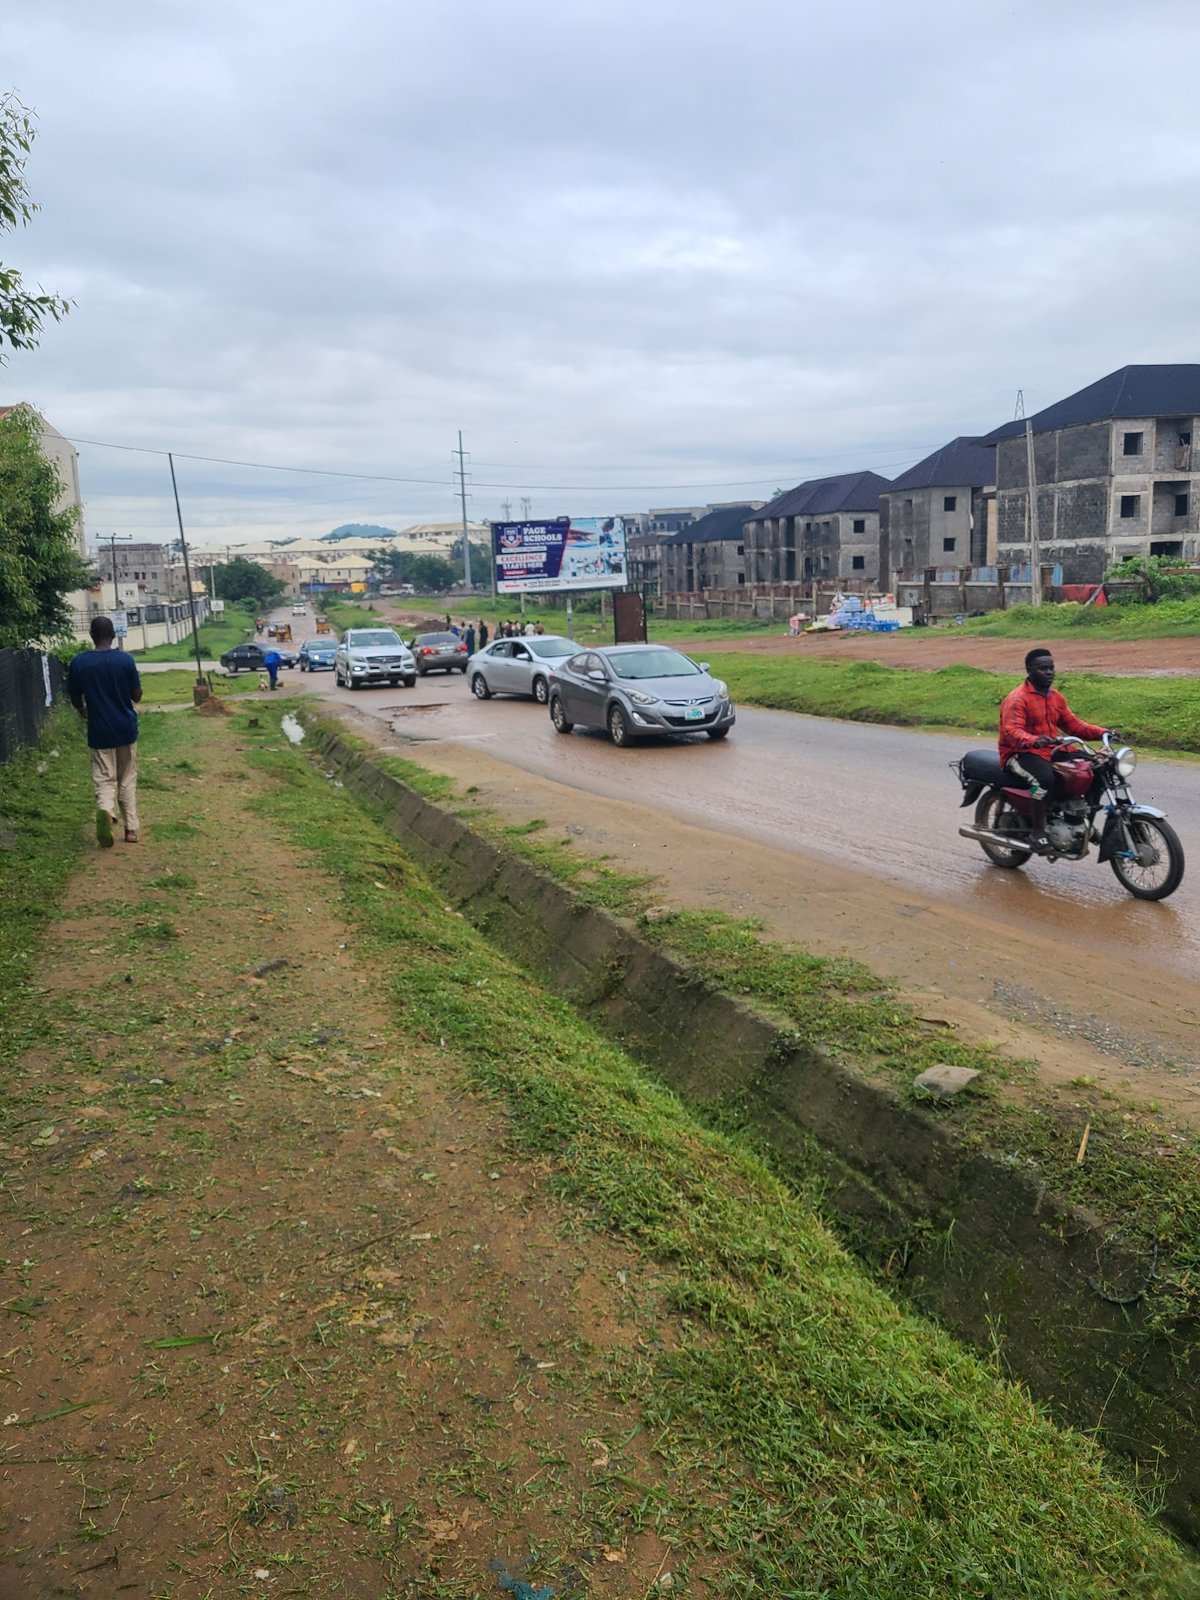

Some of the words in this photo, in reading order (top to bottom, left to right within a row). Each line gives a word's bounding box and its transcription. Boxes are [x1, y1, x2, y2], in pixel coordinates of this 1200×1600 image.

[523, 533, 562, 543] SCHOOLS
[501, 554, 543, 562] EXCELLENCE
[502, 562, 527, 570] STARTS
[527, 561, 544, 569] HERE
